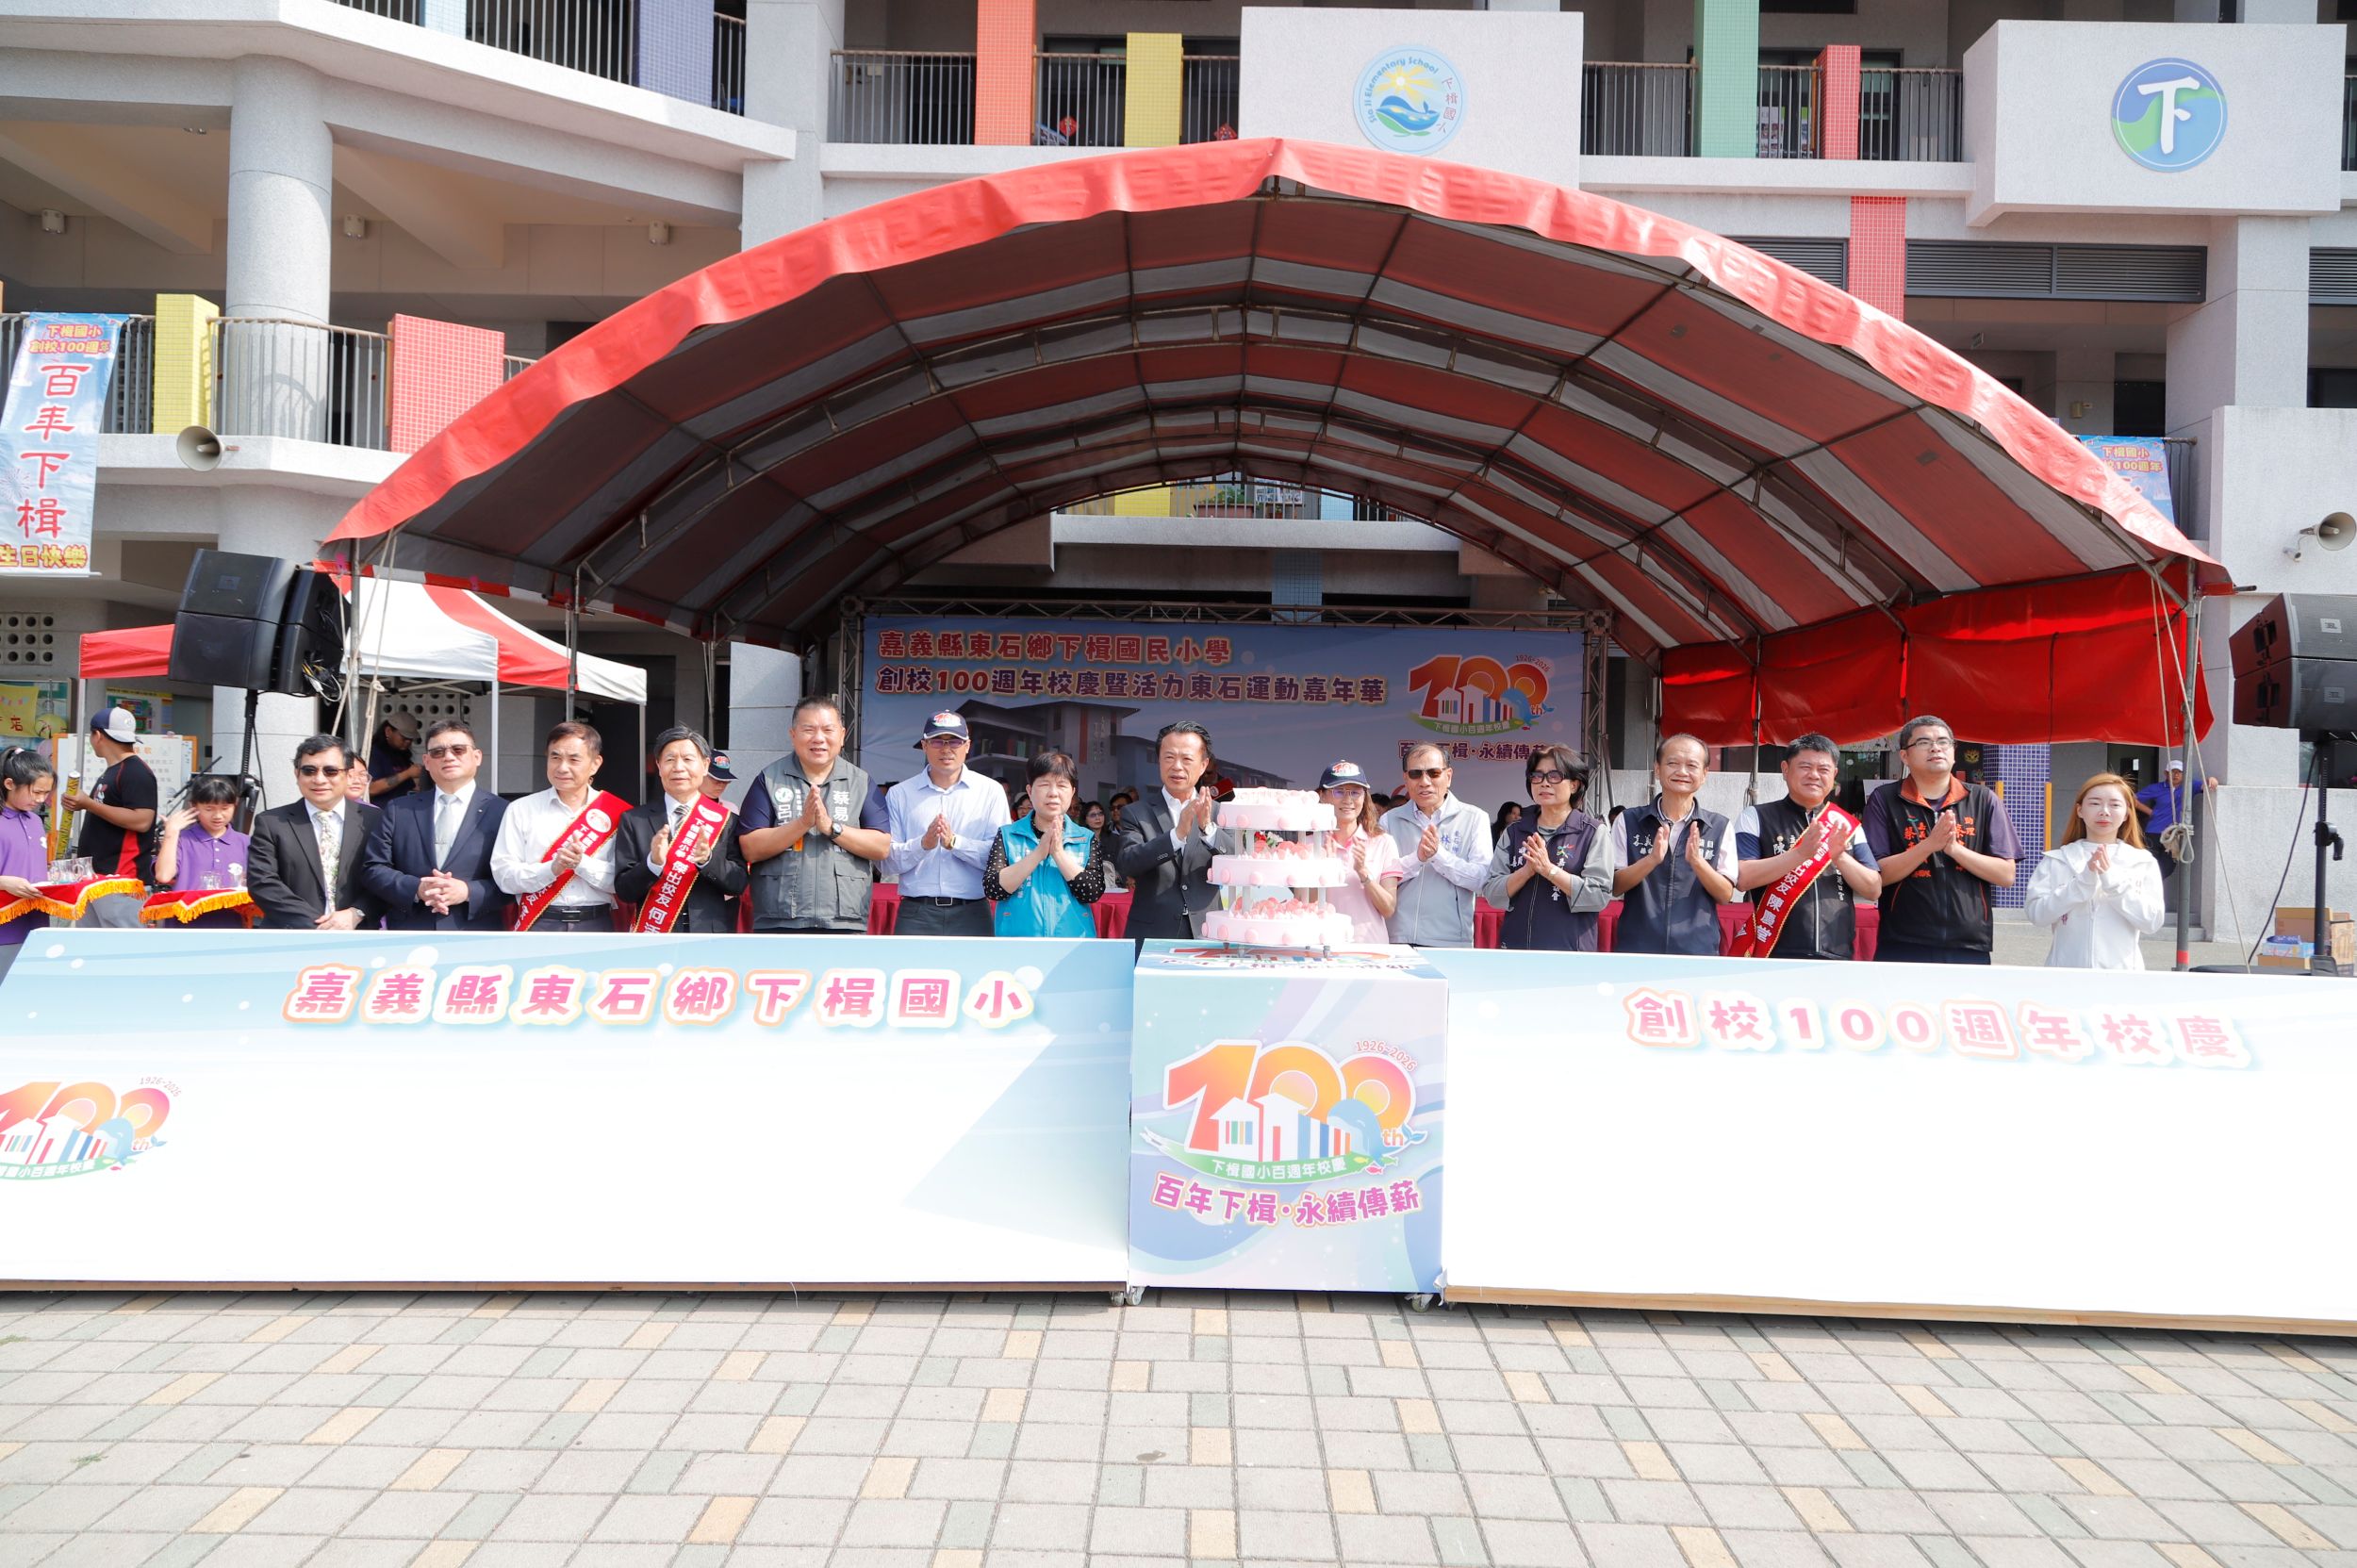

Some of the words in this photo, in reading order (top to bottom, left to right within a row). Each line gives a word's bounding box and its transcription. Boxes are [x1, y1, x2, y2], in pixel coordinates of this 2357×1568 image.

[1365, 58, 1406, 97] Elementary
[1409, 56, 1440, 74] School
[2137, 74, 2200, 155] 下
[29, 339, 111, 355] 創校100週年
[46, 323, 103, 339] 下楫國小
[17, 364, 91, 540] 百年下楫
[0, 544, 90, 569] 生日快樂
[878, 630, 1232, 665] 嘉義縣東石鄉下楫國民小學
[877, 665, 1386, 703] 創校100週年校慶暨活力東石運動嘉年華
[655, 860, 689, 908] 傑出校友
[291, 969, 1028, 1023] 嘉義縣東石鄉下楫國小
[1631, 993, 2242, 1060] 創校100週年校慶
[1380, 1128, 1404, 1147] th
[1212, 1158, 1346, 1180] 下楫國小百週年校慶
